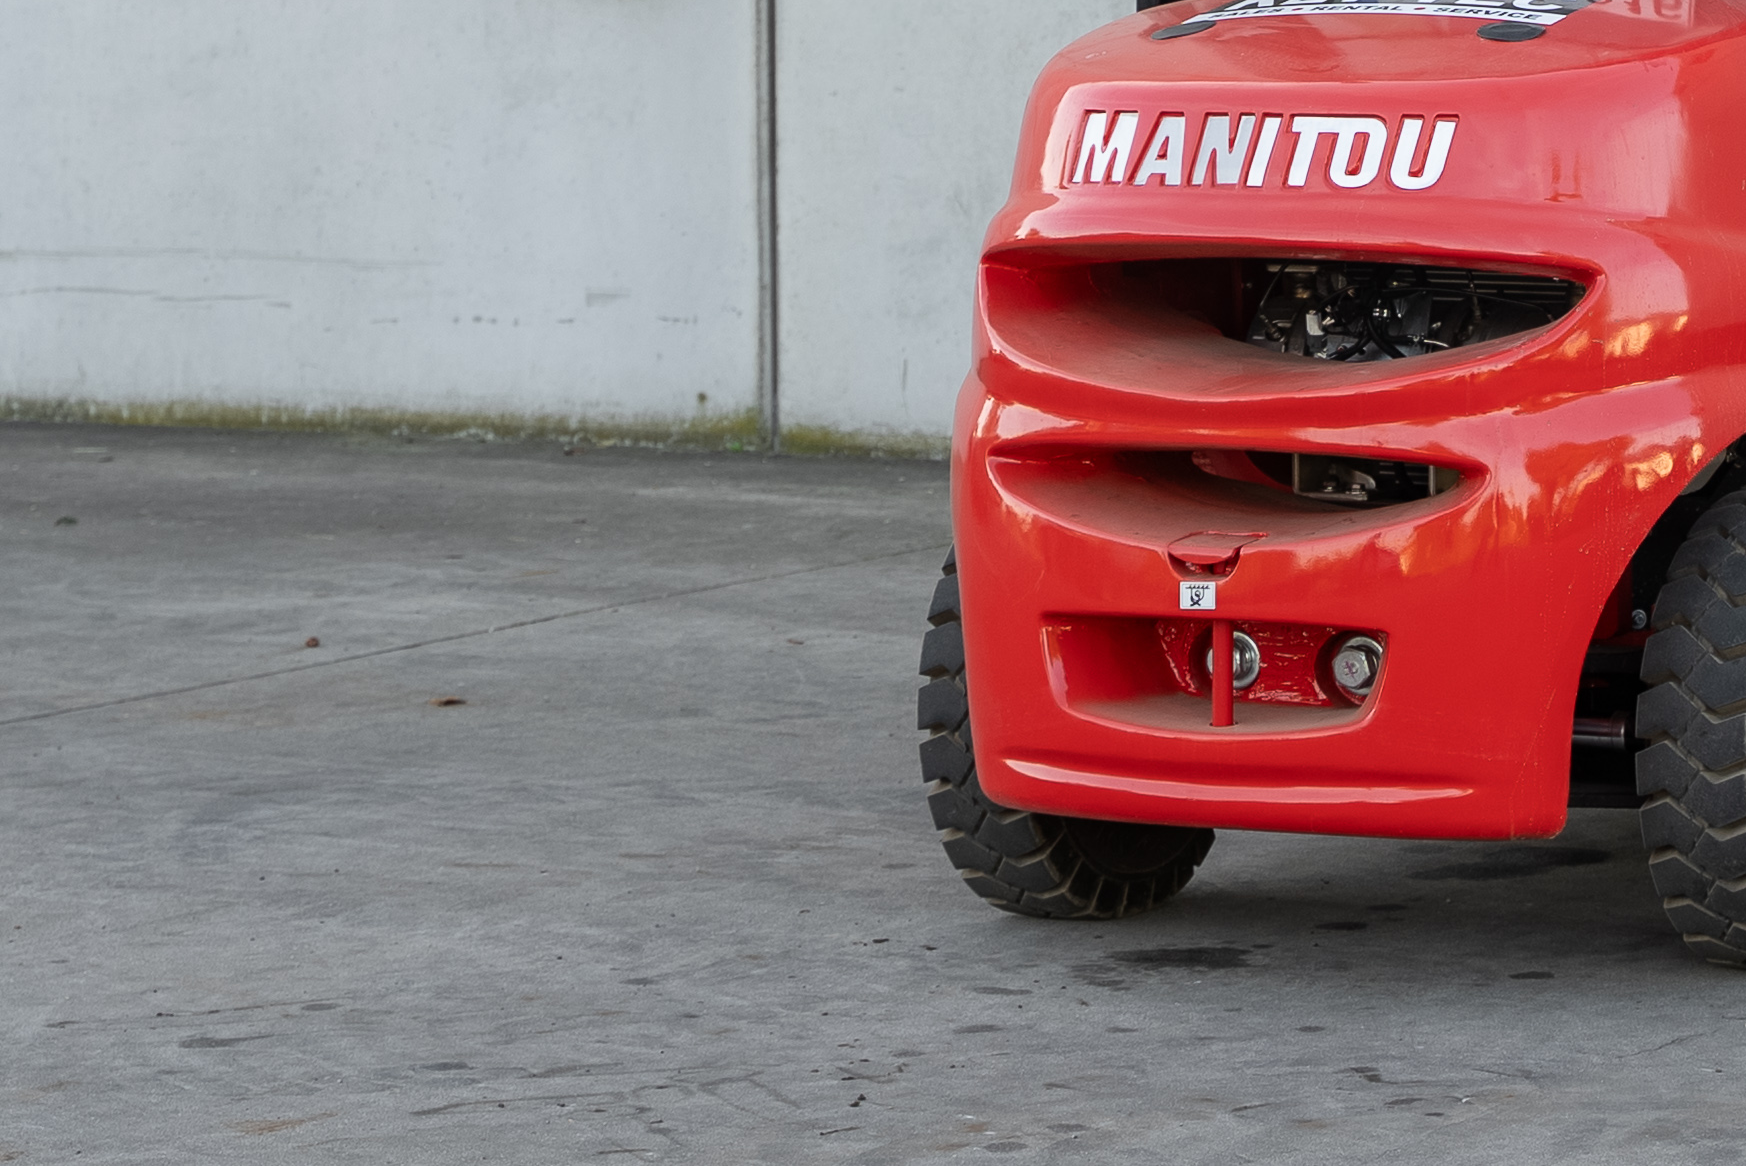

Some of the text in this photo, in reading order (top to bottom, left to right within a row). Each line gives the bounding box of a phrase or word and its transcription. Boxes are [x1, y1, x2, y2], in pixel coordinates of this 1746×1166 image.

[1208, 4, 1543, 20] SALES RENTAL SERVICE
[1071, 110, 1459, 190] MANITOU
